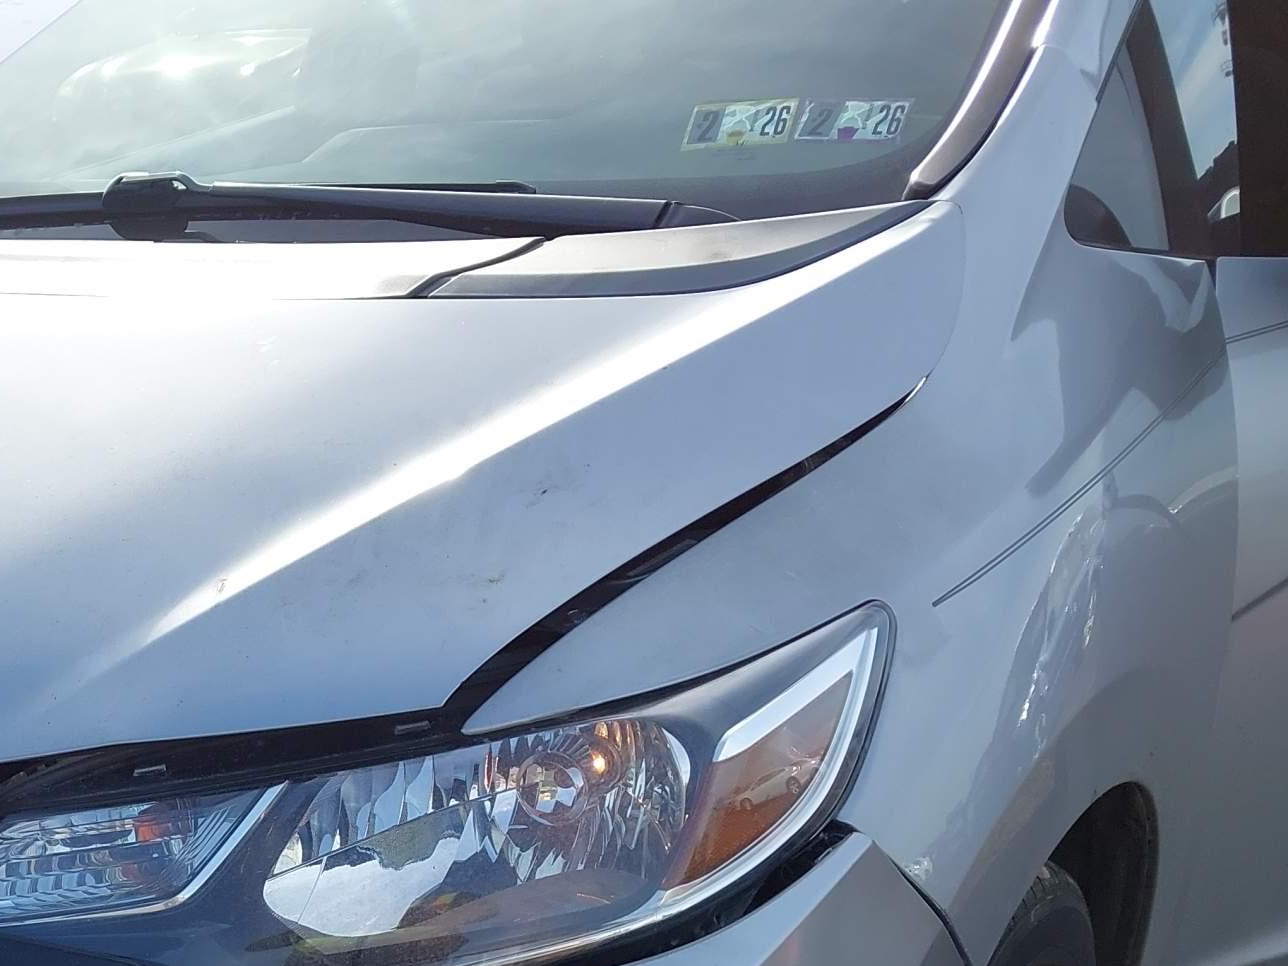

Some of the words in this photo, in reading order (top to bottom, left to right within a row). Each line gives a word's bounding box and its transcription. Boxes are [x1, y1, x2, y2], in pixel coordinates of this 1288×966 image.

[697, 111, 715, 142] 2
[759, 105, 791, 136] 26
[809, 108, 832, 136] 2
[872, 105, 905, 136] 26
